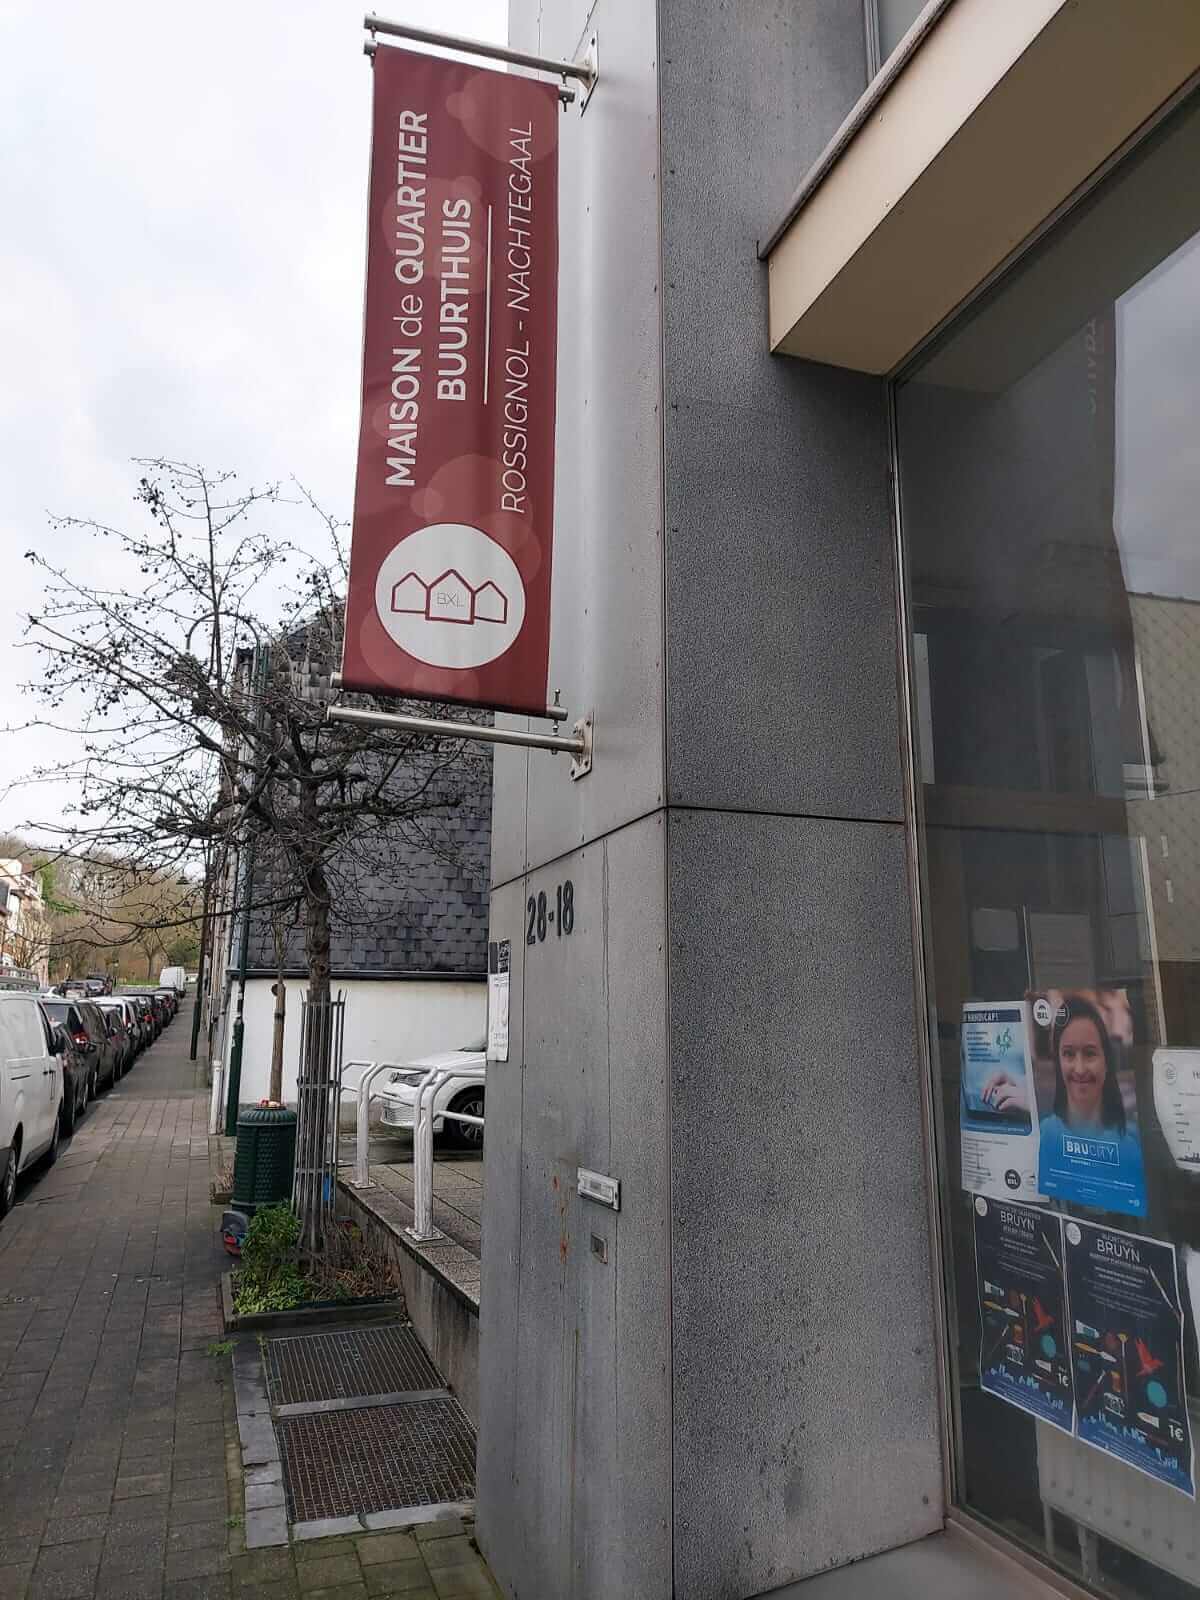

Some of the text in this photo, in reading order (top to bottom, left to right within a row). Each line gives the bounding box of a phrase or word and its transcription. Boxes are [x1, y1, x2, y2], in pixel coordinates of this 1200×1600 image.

[506, 121, 533, 311] NACHTEGAAL
[385, 110, 428, 487] MAISON de QUARTIER
[436, 198, 472, 401] BUURTHUIS
[501, 341, 529, 514] ROSSIGNOL
[436, 591, 465, 608] BXL
[527, 880, 574, 945] 28-18
[1066, 1140, 1114, 1160] BRUCITY
[1000, 1210, 1035, 1231] BRUYN
[1096, 1238, 1140, 1263] BRUYN
